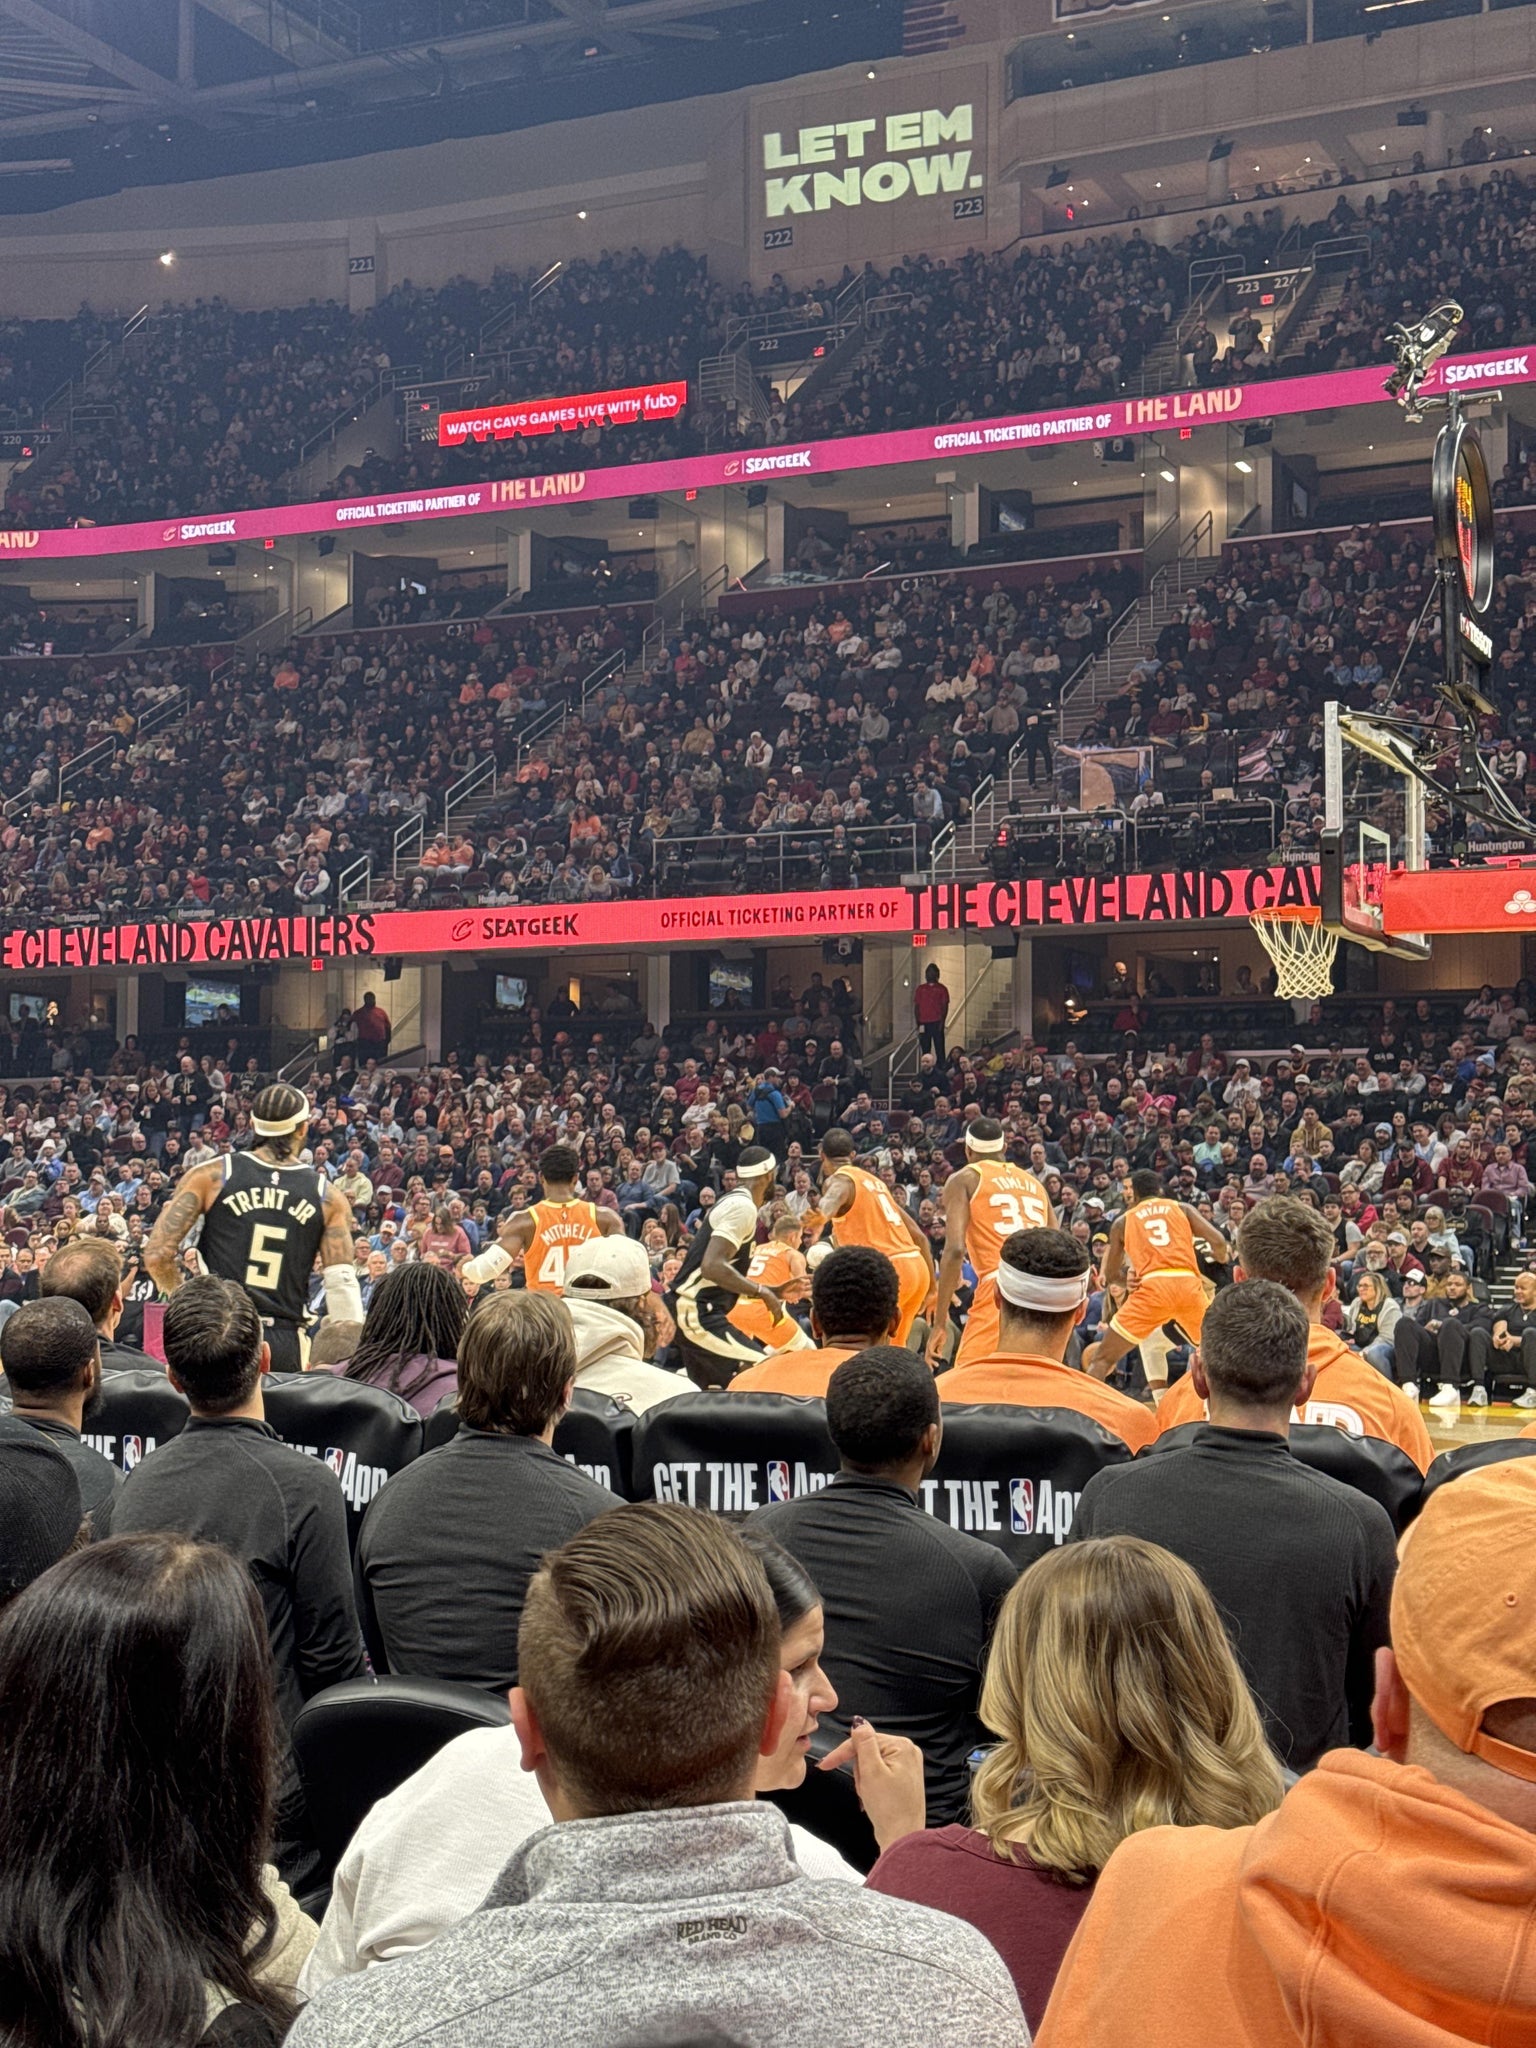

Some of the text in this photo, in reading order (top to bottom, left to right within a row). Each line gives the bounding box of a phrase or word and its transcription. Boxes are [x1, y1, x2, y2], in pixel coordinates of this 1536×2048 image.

[764, 104, 973, 170] LET EM
[765, 150, 983, 218] KNOW.
[954, 199, 983, 217] 223
[765, 230, 792, 248] 222
[350, 258, 374, 273] 221
[1236, 281, 1260, 295] 223
[759, 339, 779, 351] 222
[1445, 355, 1530, 384] SEATGEEK
[446, 393, 679, 436] WATCH CAVS GAMES LIVE WITH fubo
[933, 430, 983, 450] OFFICIAL
[983, 421, 1042, 444] TICKETING
[1042, 415, 1094, 437] PARTNER
[1096, 413, 1113, 429] OF
[1172, 387, 1244, 418] LAND
[745, 450, 812, 474] SEATGEEK
[336, 505, 377, 521] OFFICIAL
[377, 500, 424, 517] TICKETING
[424, 496, 466, 511] PARTNER
[467, 492, 481, 507] OF
[529, 471, 586, 499] LAND
[181, 519, 236, 540] SEATGEEK
[1467, 840, 1526, 853] Huntington
[660, 909, 725, 929] OFFICIAL
[727, 906, 805, 925] TICKETING
[808, 902, 875, 921] PARTNER
[879, 901, 899, 918] OF
[905, 883, 978, 931] THE
[988, 868, 1233, 928] CLEVELAND
[20, 922, 197, 968] CLEVELAND
[204, 913, 376, 960] CAVALIERS
[482, 913, 580, 940] SEATGEEK
[222, 1187, 317, 1225] TRENT JR
[877, 1193, 903, 1227] 4
[989, 1193, 1047, 1236] 35
[540, 1223, 594, 1247] MITCHELL
[1143, 1218, 1171, 1247] 3
[245, 1223, 288, 1291] 5
[746, 1255, 770, 1277] 5
[652, 1462, 702, 1509] GET
[706, 1462, 760, 1511] THE
[944, 1479, 1002, 1531] THE
[676, 1915, 748, 1942] RED HEAD
